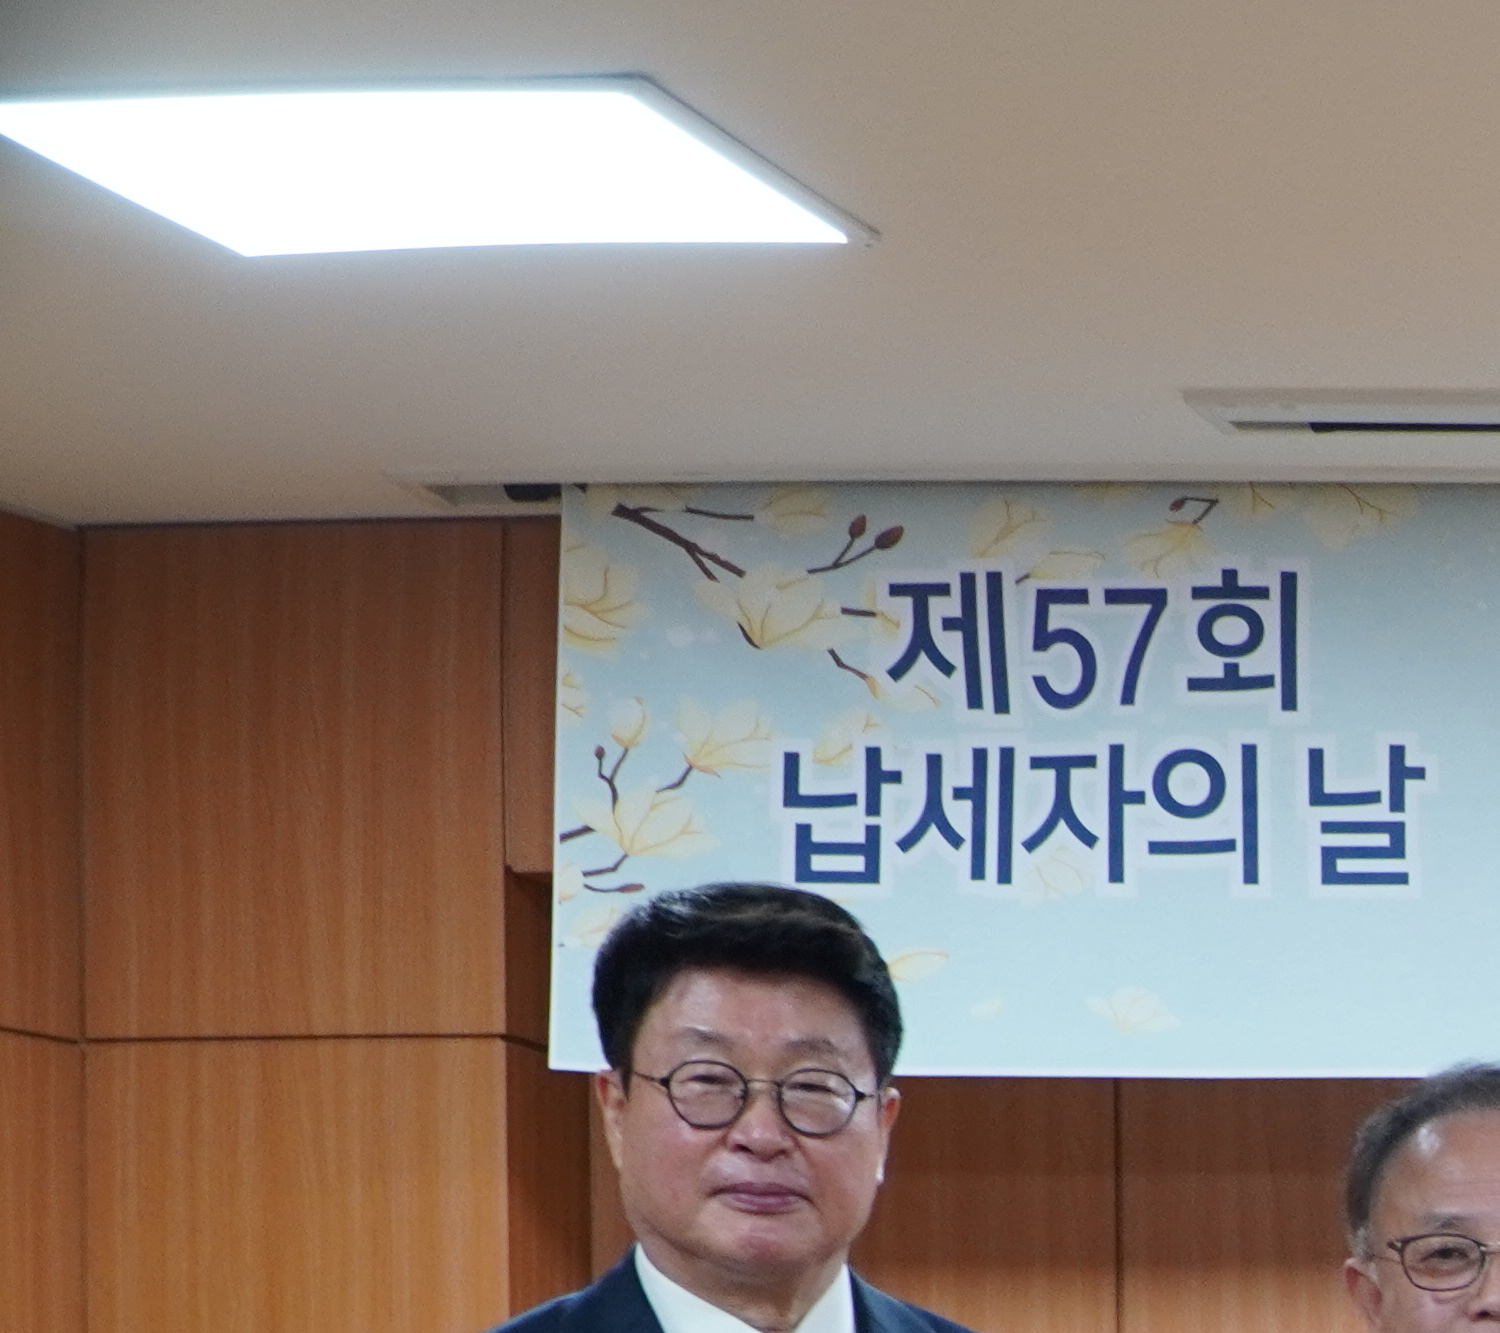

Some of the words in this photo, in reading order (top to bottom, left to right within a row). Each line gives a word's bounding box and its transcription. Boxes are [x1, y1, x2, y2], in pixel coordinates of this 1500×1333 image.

[886, 566, 1300, 714] 제57회
[780, 742, 1262, 885] 납세자의
[1307, 742, 1427, 887] 날
